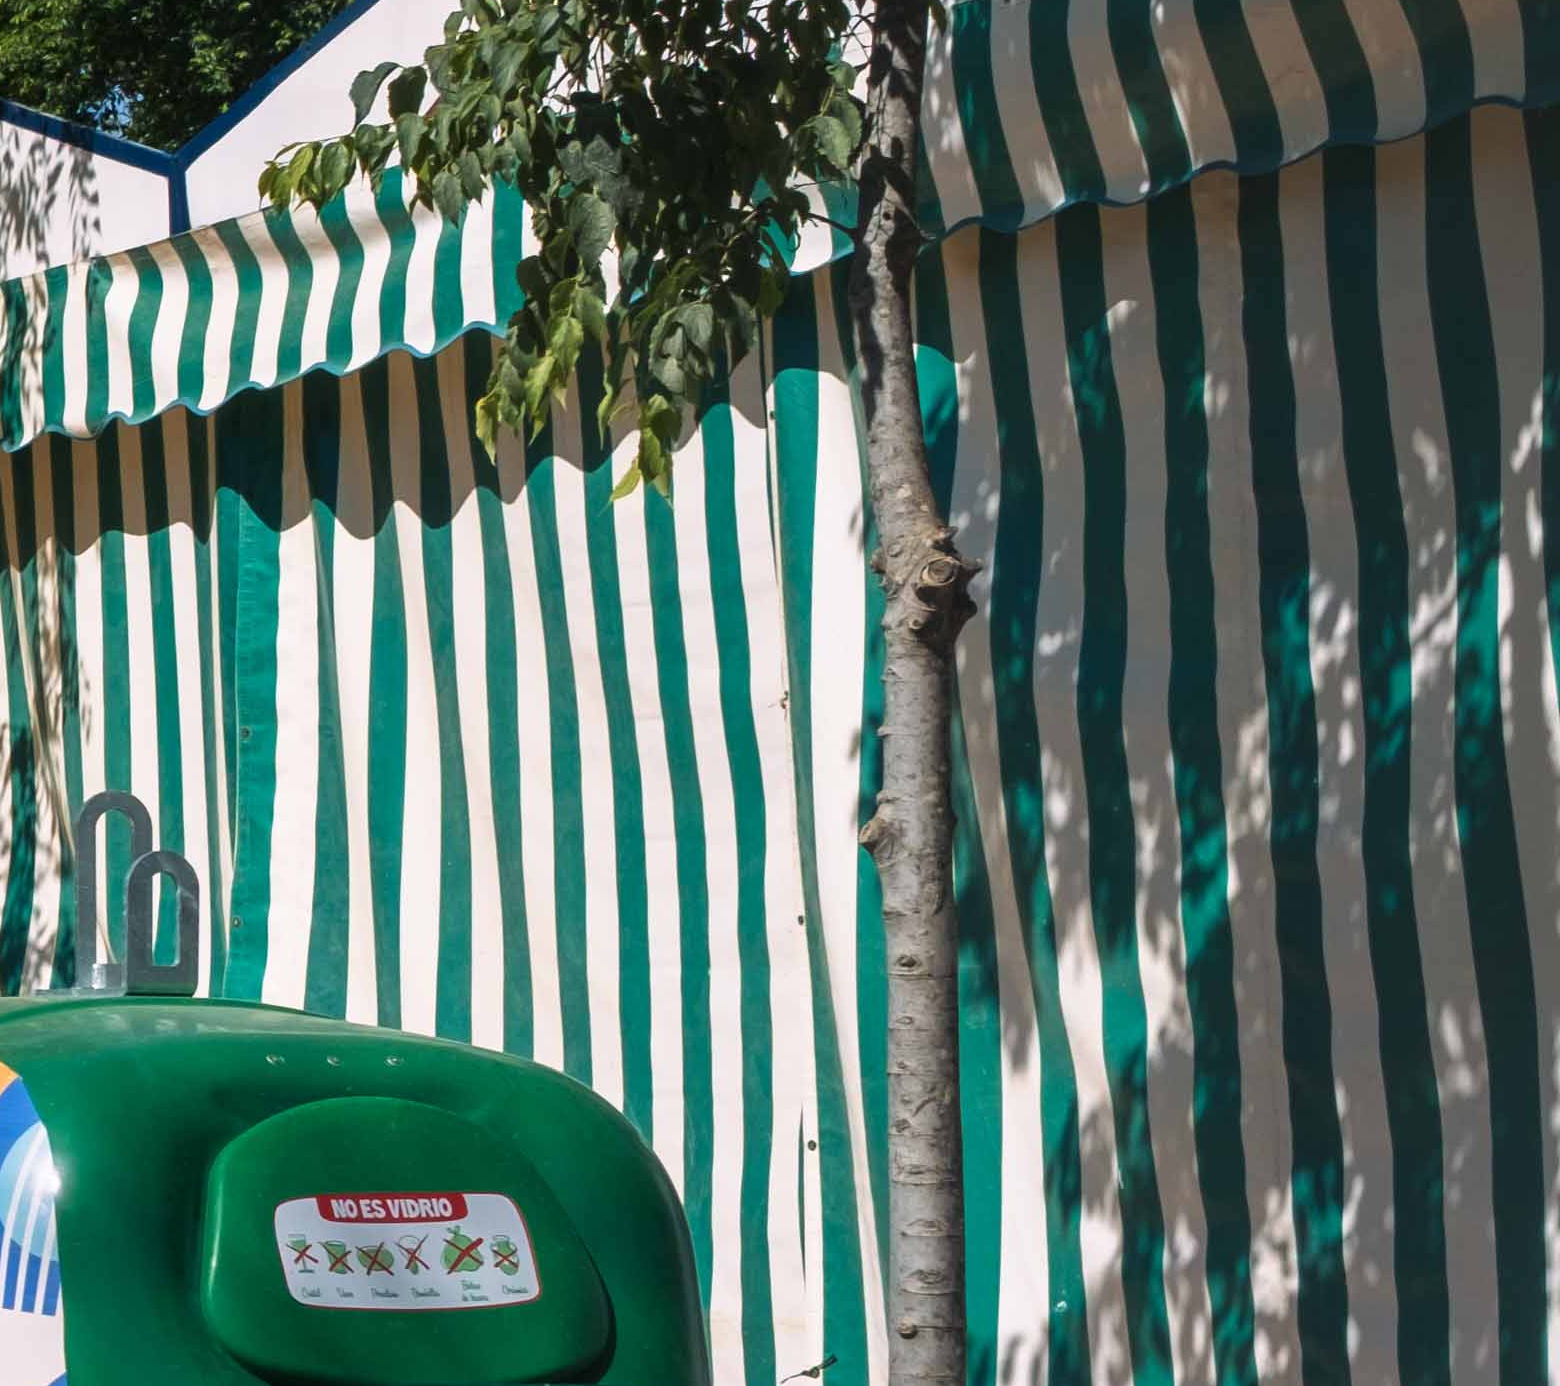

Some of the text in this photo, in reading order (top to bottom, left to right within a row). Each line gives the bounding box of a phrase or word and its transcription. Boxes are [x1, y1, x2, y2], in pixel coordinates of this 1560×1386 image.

[330, 1197, 453, 1219] NO ES VIDRIO
